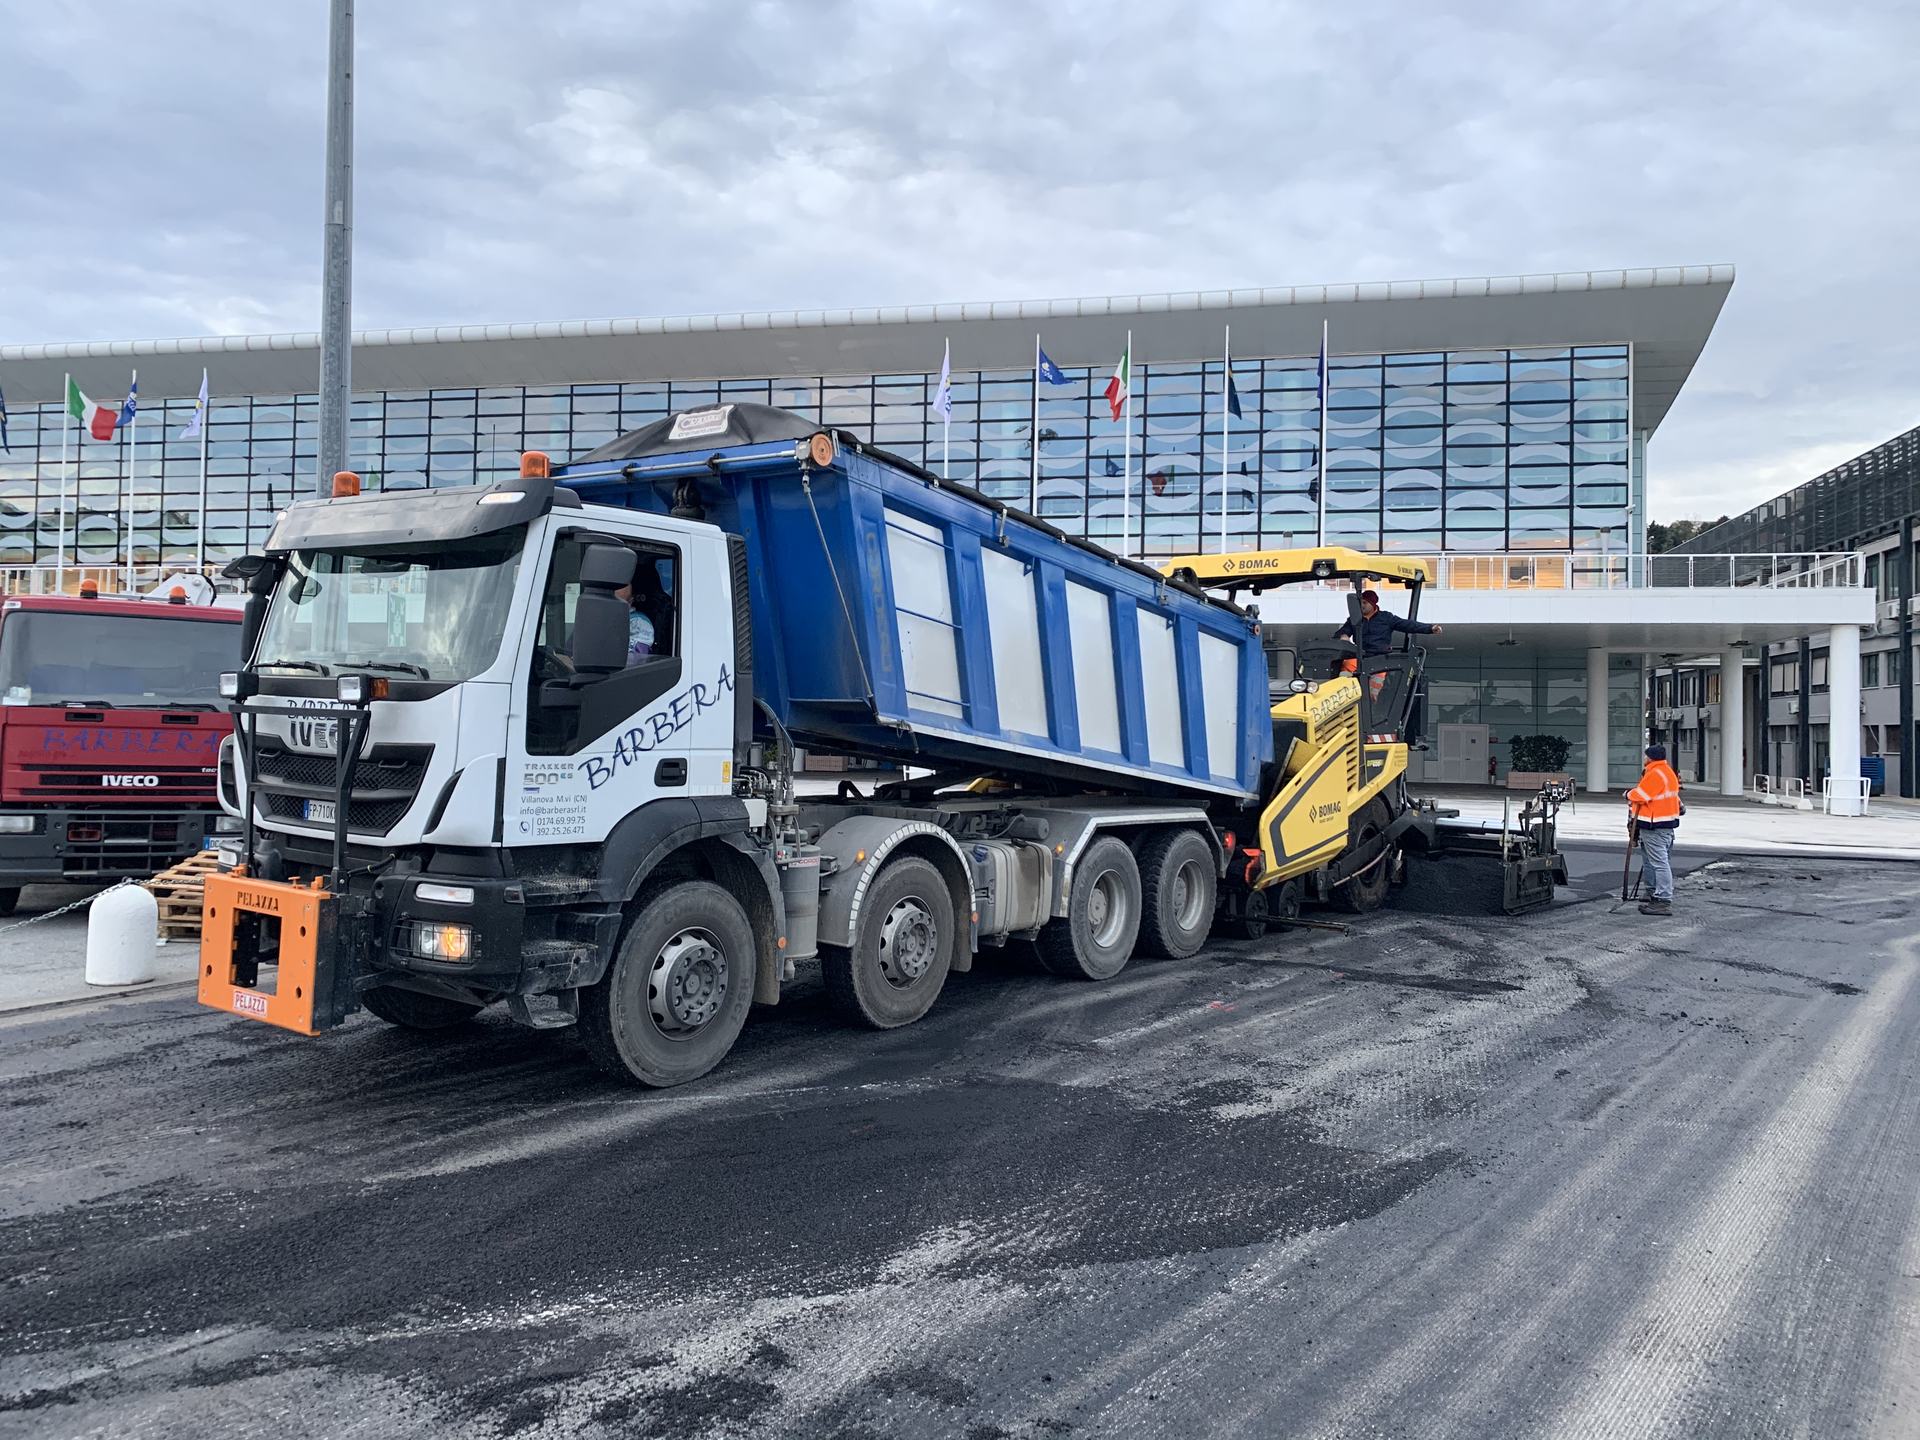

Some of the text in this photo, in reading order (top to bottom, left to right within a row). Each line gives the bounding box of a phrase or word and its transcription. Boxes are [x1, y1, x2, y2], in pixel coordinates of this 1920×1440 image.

[1239, 559, 1279, 570] BOMAG
[577, 662, 734, 790] BARBERA
[43, 727, 219, 753] BARBERA
[102, 775, 159, 787] IVECO
[523, 772, 559, 785] 500
[521, 795, 554, 804] Villanova
[574, 794, 588, 804] (CN)
[520, 805, 587, 816] info@barberasrl.it
[1319, 801, 1341, 818] BOMAG
[536, 816, 586, 826] 0174.69.99.75
[536, 826, 585, 836] 392.25.26.471
[237, 891, 279, 912] PELAZZA
[235, 992, 265, 1013] PELAZZA
